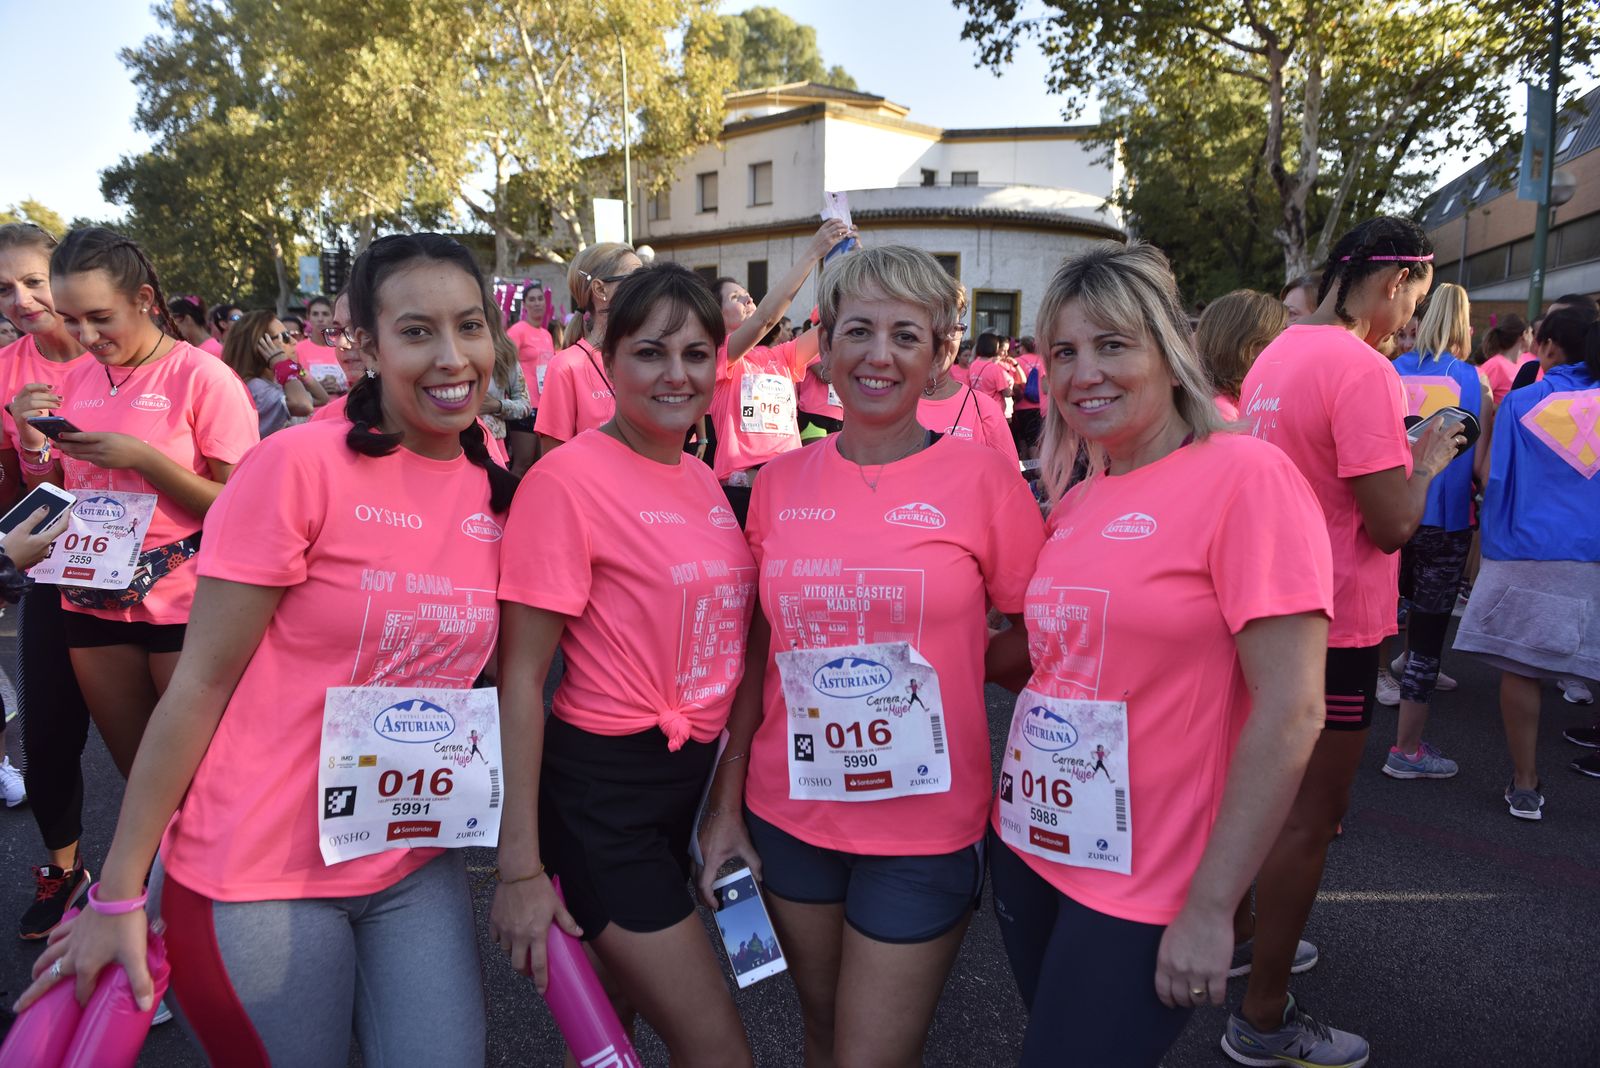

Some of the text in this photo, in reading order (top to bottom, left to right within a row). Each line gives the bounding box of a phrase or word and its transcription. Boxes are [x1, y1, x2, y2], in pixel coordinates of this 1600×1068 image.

[73, 399, 105, 411] OYSHO
[134, 400, 168, 410] ASTURIANA
[760, 402, 780, 415] 016
[76, 505, 121, 518] ASTURIANA
[355, 504, 423, 530] OYSHO
[639, 510, 687, 525] OYSHO
[779, 508, 837, 521] OYSHO
[889, 511, 941, 526] ASTURIANA
[1107, 524, 1152, 536] ASTURIANA
[64, 533, 110, 553] 016
[68, 555, 92, 565] 2559
[792, 558, 843, 577] GANAN
[669, 561, 701, 586] HOY
[765, 559, 788, 578] HOY
[360, 568, 397, 593] HOY
[405, 572, 454, 596] GANAN
[804, 586, 846, 598] VITORIA
[856, 585, 904, 600] GASTEIZ
[421, 605, 458, 619] VITORIA
[466, 607, 495, 621] GASTEIZ
[827, 599, 871, 612] MADRID
[1055, 604, 1089, 621] GASTEIZ
[438, 619, 477, 634] MADRID
[819, 673, 886, 689] ASTURIANA
[866, 695, 900, 706] Carrera
[888, 703, 911, 718] Mujer
[381, 715, 451, 733] ASTURIANA
[1023, 719, 1072, 744] ASTURIANA
[825, 719, 892, 749] 016
[433, 742, 464, 753] Carrera
[844, 753, 878, 768] 5990
[1051, 752, 1085, 767] Carrera
[378, 767, 454, 797] 016
[798, 777, 832, 787] OYSHO
[856, 778, 886, 786] Santander
[910, 778, 940, 787] ZURICH
[1021, 769, 1074, 808] 016
[392, 802, 431, 816] 5991
[1030, 807, 1059, 827] 5988
[401, 826, 433, 834] Santander
[456, 830, 486, 840] ZURICH
[329, 830, 371, 847] OYSHO
[1039, 834, 1064, 847] Santander
[1088, 851, 1119, 863] ZURICH
